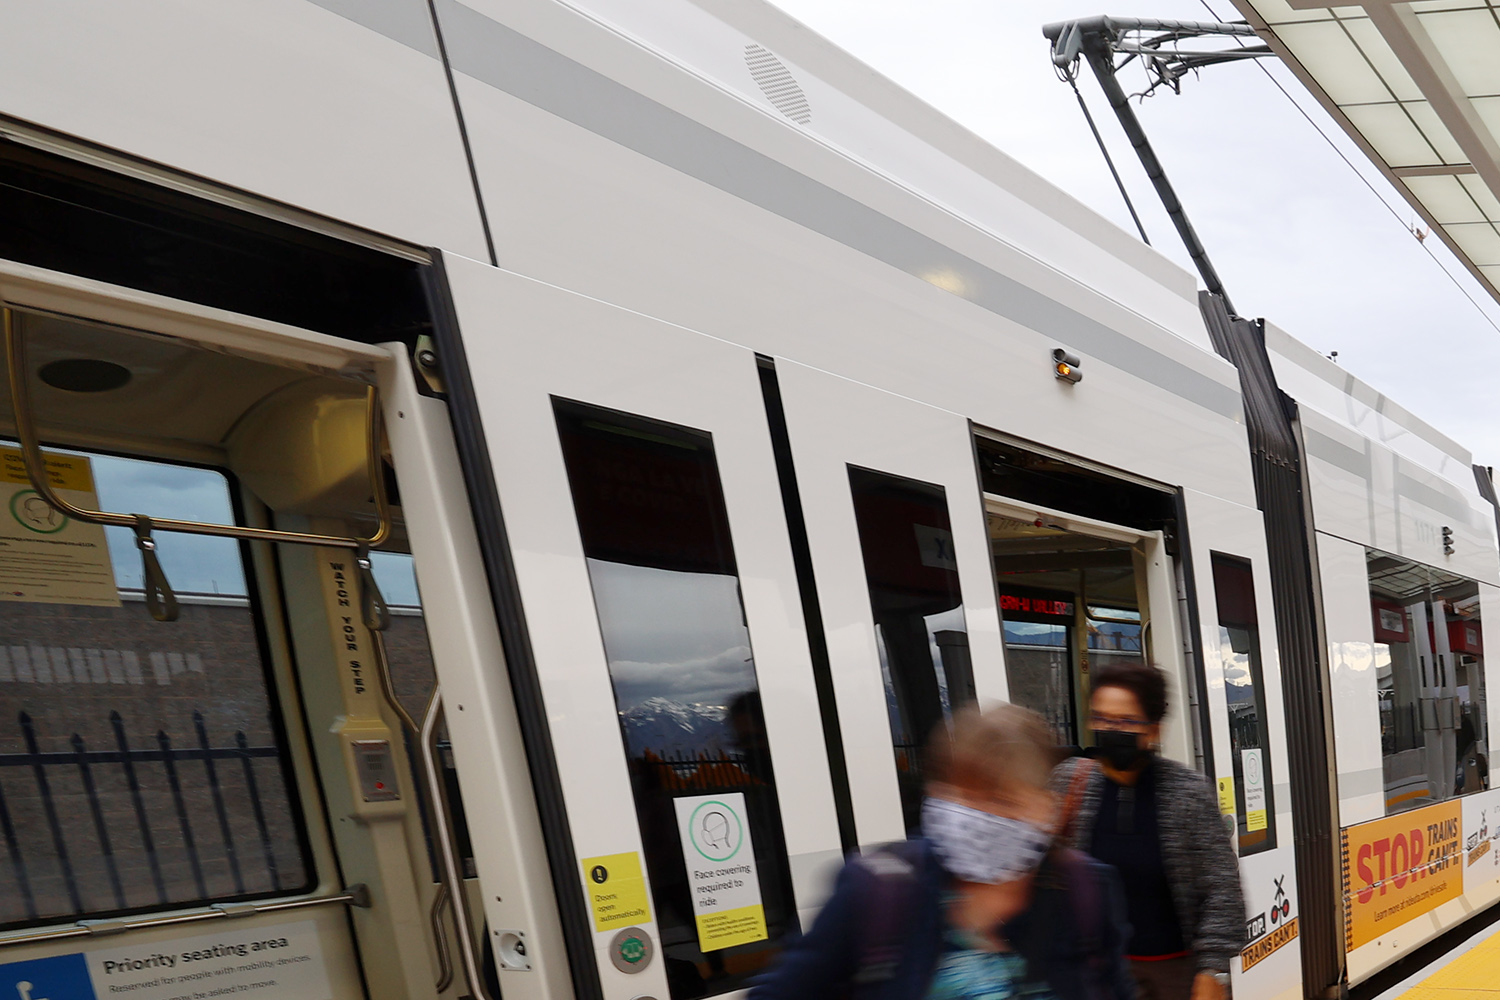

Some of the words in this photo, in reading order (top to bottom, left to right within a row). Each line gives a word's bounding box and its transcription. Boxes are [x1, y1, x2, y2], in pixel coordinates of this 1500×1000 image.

[330, 562, 350, 607] WATCH
[341, 616, 358, 651] YOUR
[349, 660, 366, 694] STEP
[1427, 817, 1458, 846] TRAINS
[694, 870, 715, 880] Face
[1357, 829, 1427, 904] STOP.
[697, 880, 733, 894] required
[1246, 917, 1266, 939] TOP.
[103, 953, 178, 975] Priority
[181, 943, 249, 963] seating
[251, 938, 289, 951] area
[1242, 937, 1272, 967] TRAINS
[109, 977, 160, 993] Reserved
[161, 976, 176, 985] for
[178, 971, 212, 984] people
[214, 966, 236, 976] with
[237, 961, 275, 972] mobility
[208, 985, 236, 997] asked
[237, 983, 248, 991] to
